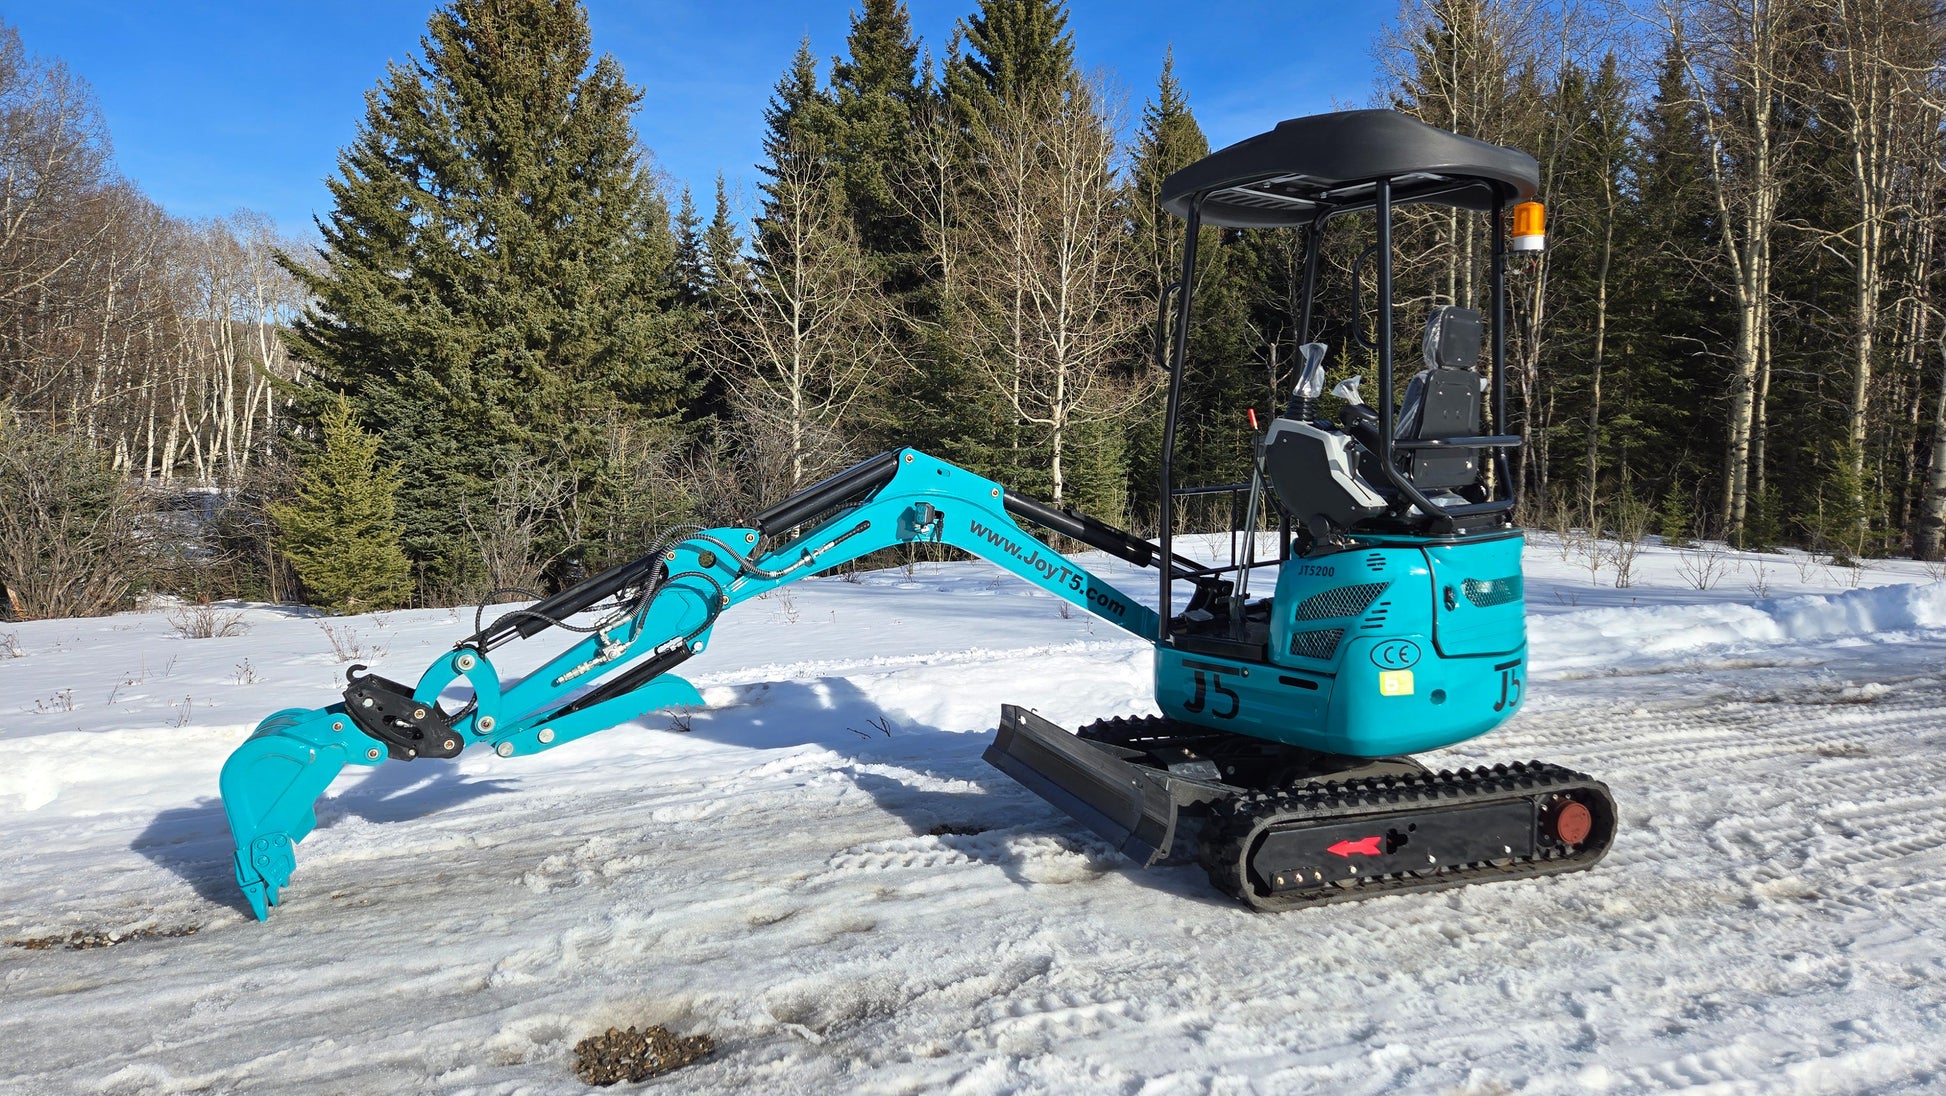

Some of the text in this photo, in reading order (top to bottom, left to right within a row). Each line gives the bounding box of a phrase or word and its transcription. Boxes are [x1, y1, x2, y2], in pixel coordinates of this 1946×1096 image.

[970, 519, 1126, 617] www.JoyT5.com
[1298, 565, 1335, 577] JT5200
[1383, 645, 1409, 664] CE
[1182, 659, 1240, 720] J5
[1493, 658, 1521, 712] J5
